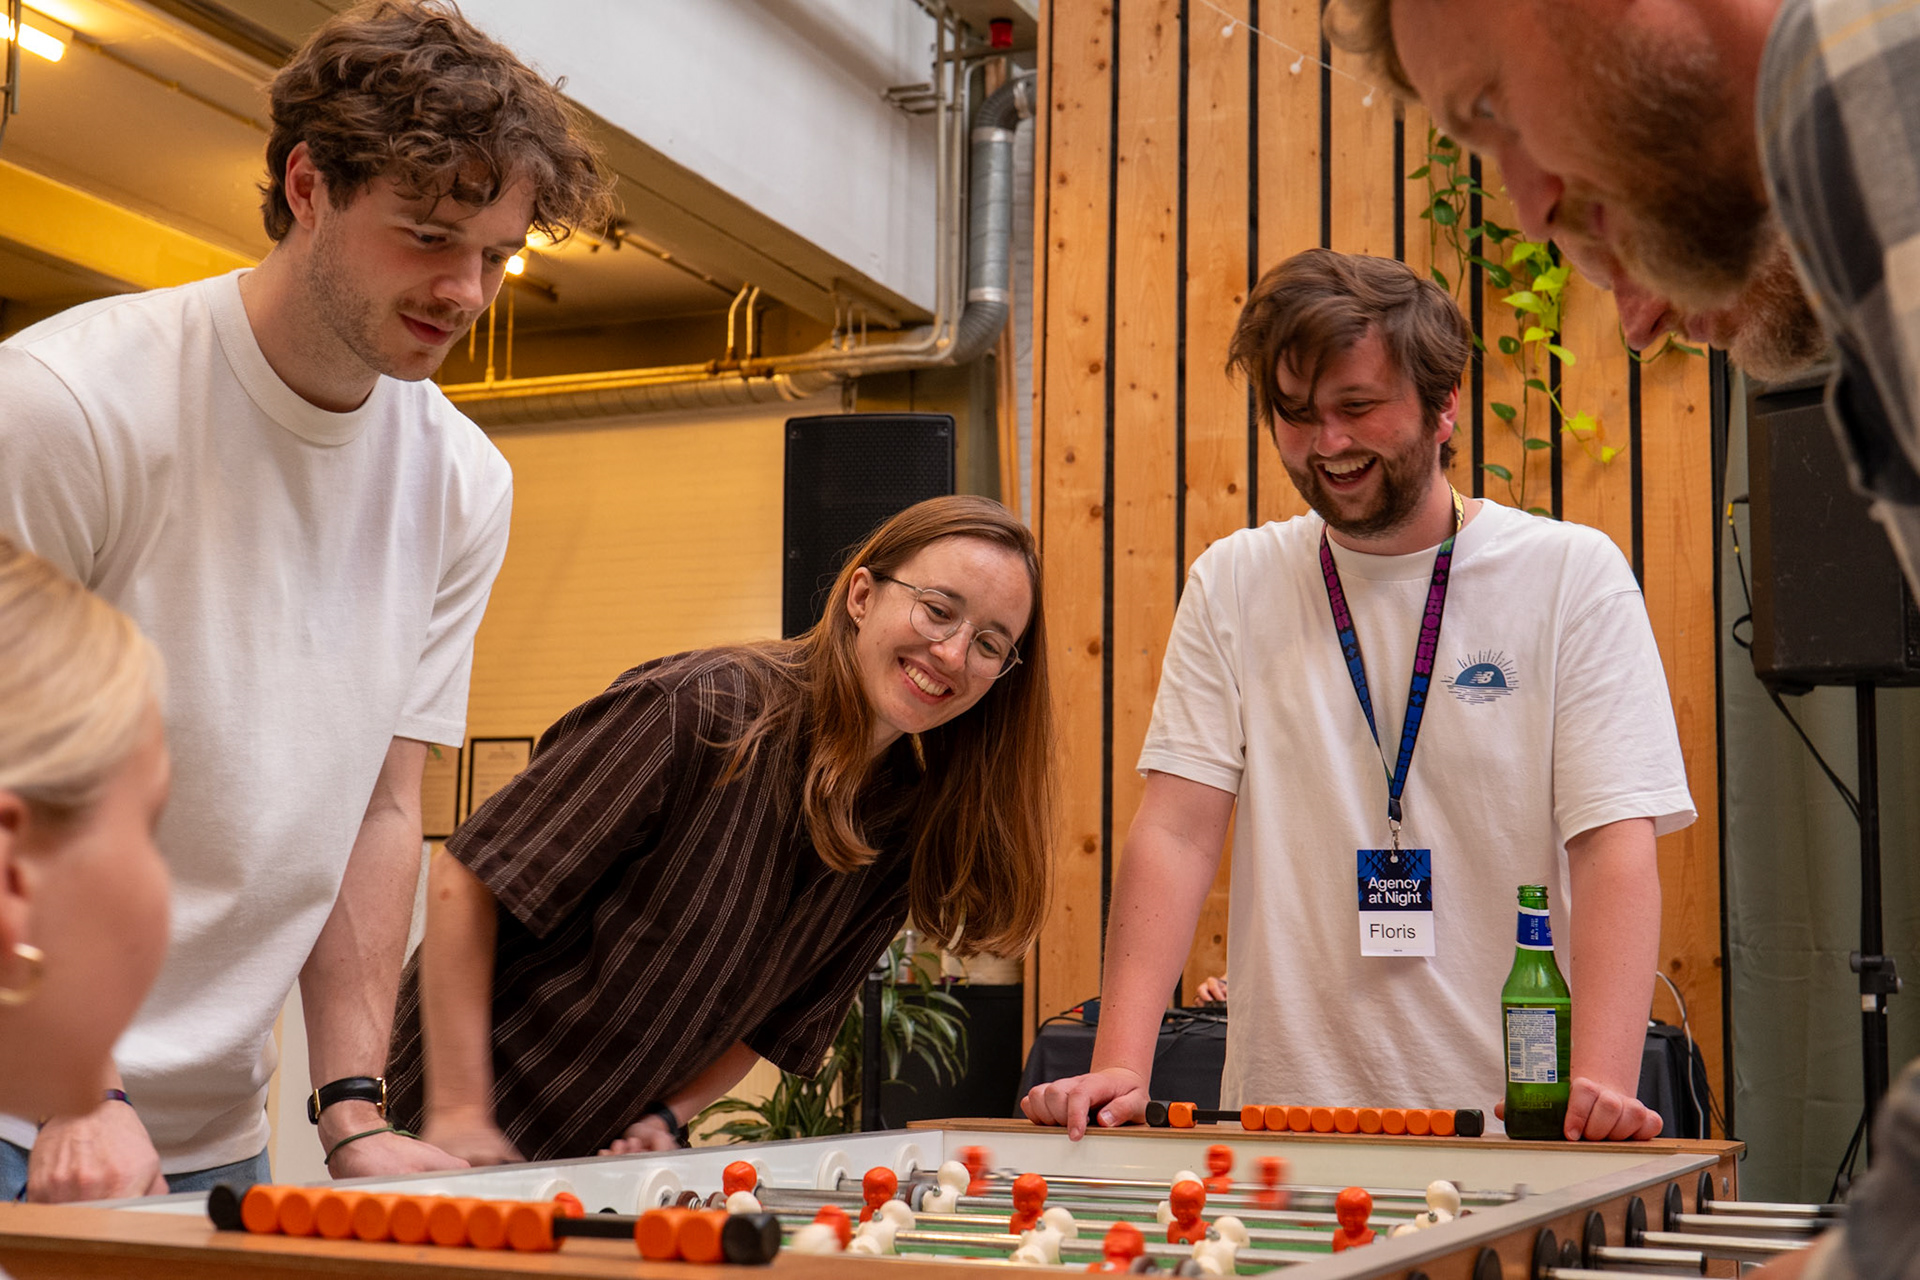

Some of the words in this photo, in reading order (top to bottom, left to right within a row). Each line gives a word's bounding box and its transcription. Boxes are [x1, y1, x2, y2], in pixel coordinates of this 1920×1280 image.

[1368, 877, 1421, 892] Agency
[1368, 892, 1382, 904] at
[1385, 891, 1422, 907] Night
[1369, 923, 1416, 939] Floris
